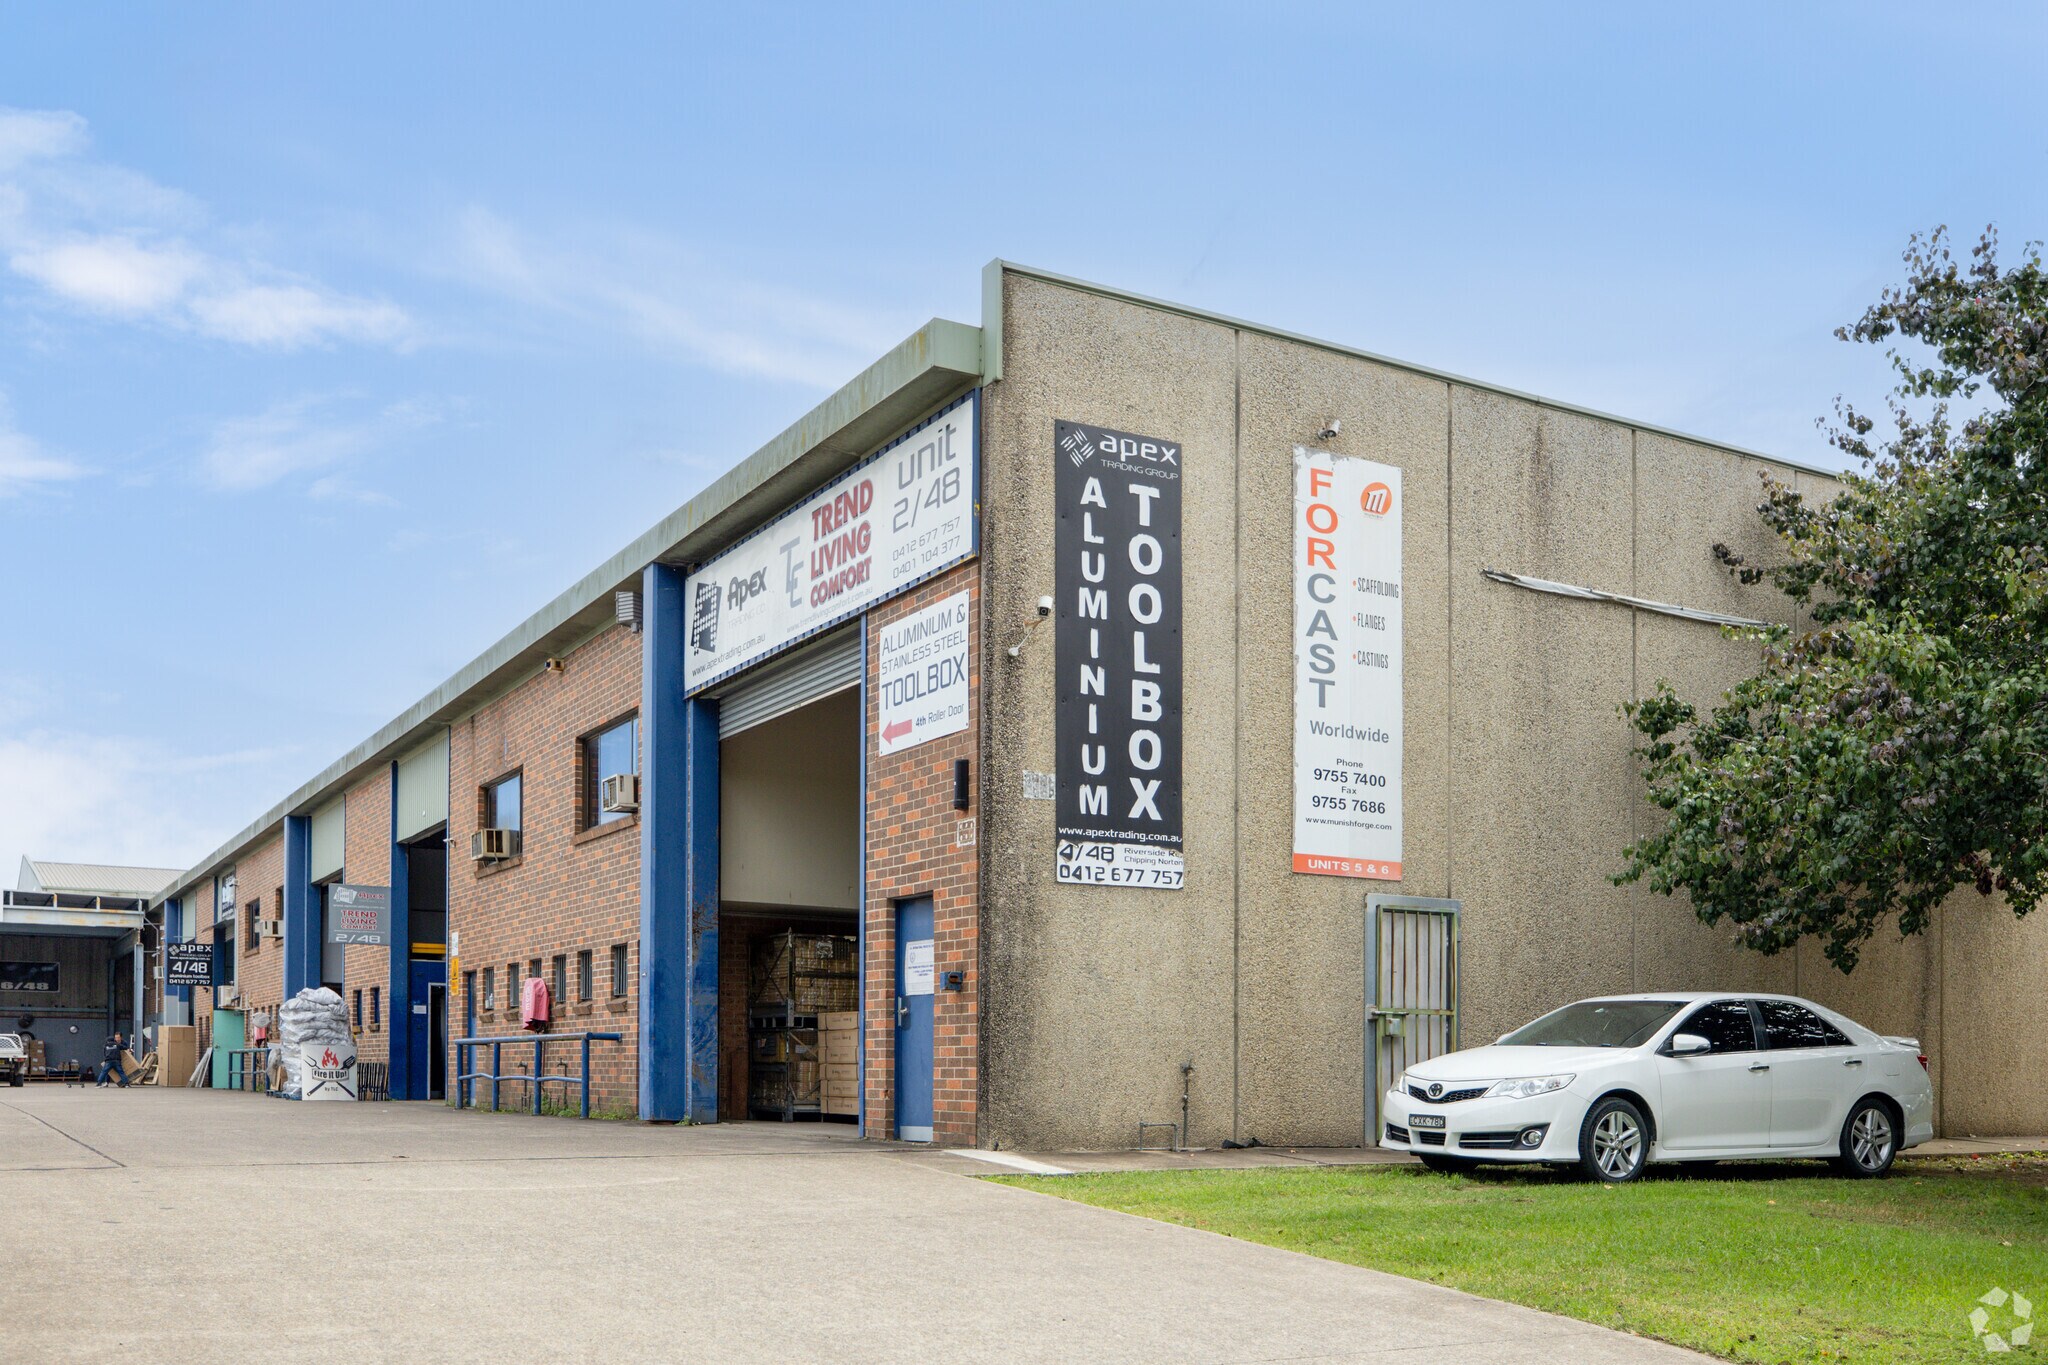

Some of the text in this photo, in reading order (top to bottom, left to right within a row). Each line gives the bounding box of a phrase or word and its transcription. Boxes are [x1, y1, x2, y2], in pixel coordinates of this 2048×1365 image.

[898, 423, 957, 490] unit
[1099, 433, 1177, 466] apex
[1101, 458, 1179, 480] TRADING GROUP
[811, 478, 873, 542] TREND
[892, 466, 960, 534] 2/48
[893, 515, 960, 561] 0412 677 757
[811, 520, 872, 580] LIVING
[893, 535, 960, 579] 0401 104 377
[810, 556, 872, 608] COMFORT
[1305, 467, 1339, 709] FORCAST
[1357, 577, 1399, 599] SCAFFOLDING
[882, 603, 966, 656] ALUMINIUM &
[1357, 612, 1386, 631] FLANGES
[692, 632, 766, 677] www.apextrading.com.au
[882, 630, 966, 676] STAINLESS STEEL
[1079, 476, 1107, 816] ALUMINIUM
[1128, 483, 1163, 821] TOOLBOX
[1357, 650, 1389, 669] CASTINGS
[881, 652, 966, 710] TOOLBOX
[915, 703, 964, 727] 4th Roller Door
[1309, 720, 1390, 744] Worldwide
[1336, 758, 1364, 769] Phone
[1313, 768, 1386, 787] 9755 7400
[1341, 786, 1357, 795] Fax
[1312, 795, 1386, 814] 9755 7686
[1305, 817, 1392, 830] www.munishforge.com
[1058, 826, 1183, 843] www.apextrading.com.au
[1059, 843, 1115, 862] 4/48
[1124, 847, 1166, 857] Riverside
[1124, 855, 1183, 866] Chipping Norton
[1059, 864, 1183, 885] 0412 677 757
[1308, 858, 1389, 874] UNITS 5 & 6
[341, 909, 377, 918] TREND
[341, 917, 377, 925] LIVING
[180, 944, 212, 954] apex
[335, 933, 381, 944] 2/48
[172, 961, 208, 974] 4/48
[0, 981, 49, 990] 6/48
[314, 1070, 327, 1078] Fire
